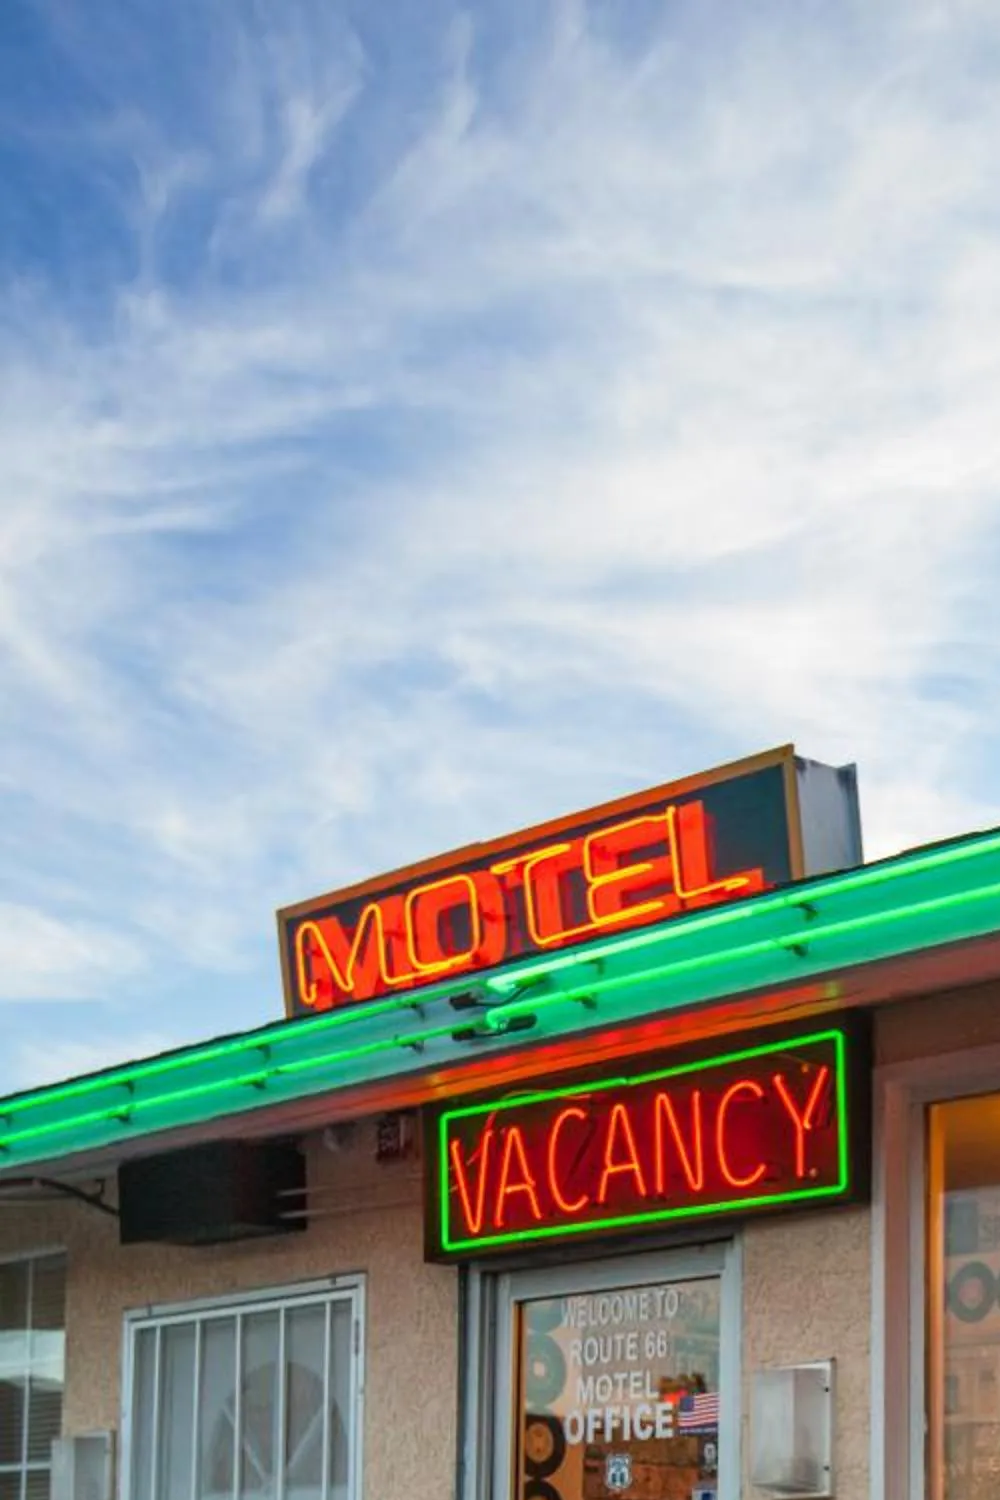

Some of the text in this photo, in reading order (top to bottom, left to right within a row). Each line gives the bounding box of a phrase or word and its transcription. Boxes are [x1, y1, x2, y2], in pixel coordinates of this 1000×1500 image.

[296, 800, 768, 1009] MOTEL
[451, 1066, 828, 1233] VACANCY
[561, 1288, 679, 1328] WELCOME TO
[570, 1330, 667, 1366] ROUTE 66
[576, 1370, 660, 1405] MOTEL
[563, 1401, 675, 1445] OFFICE
